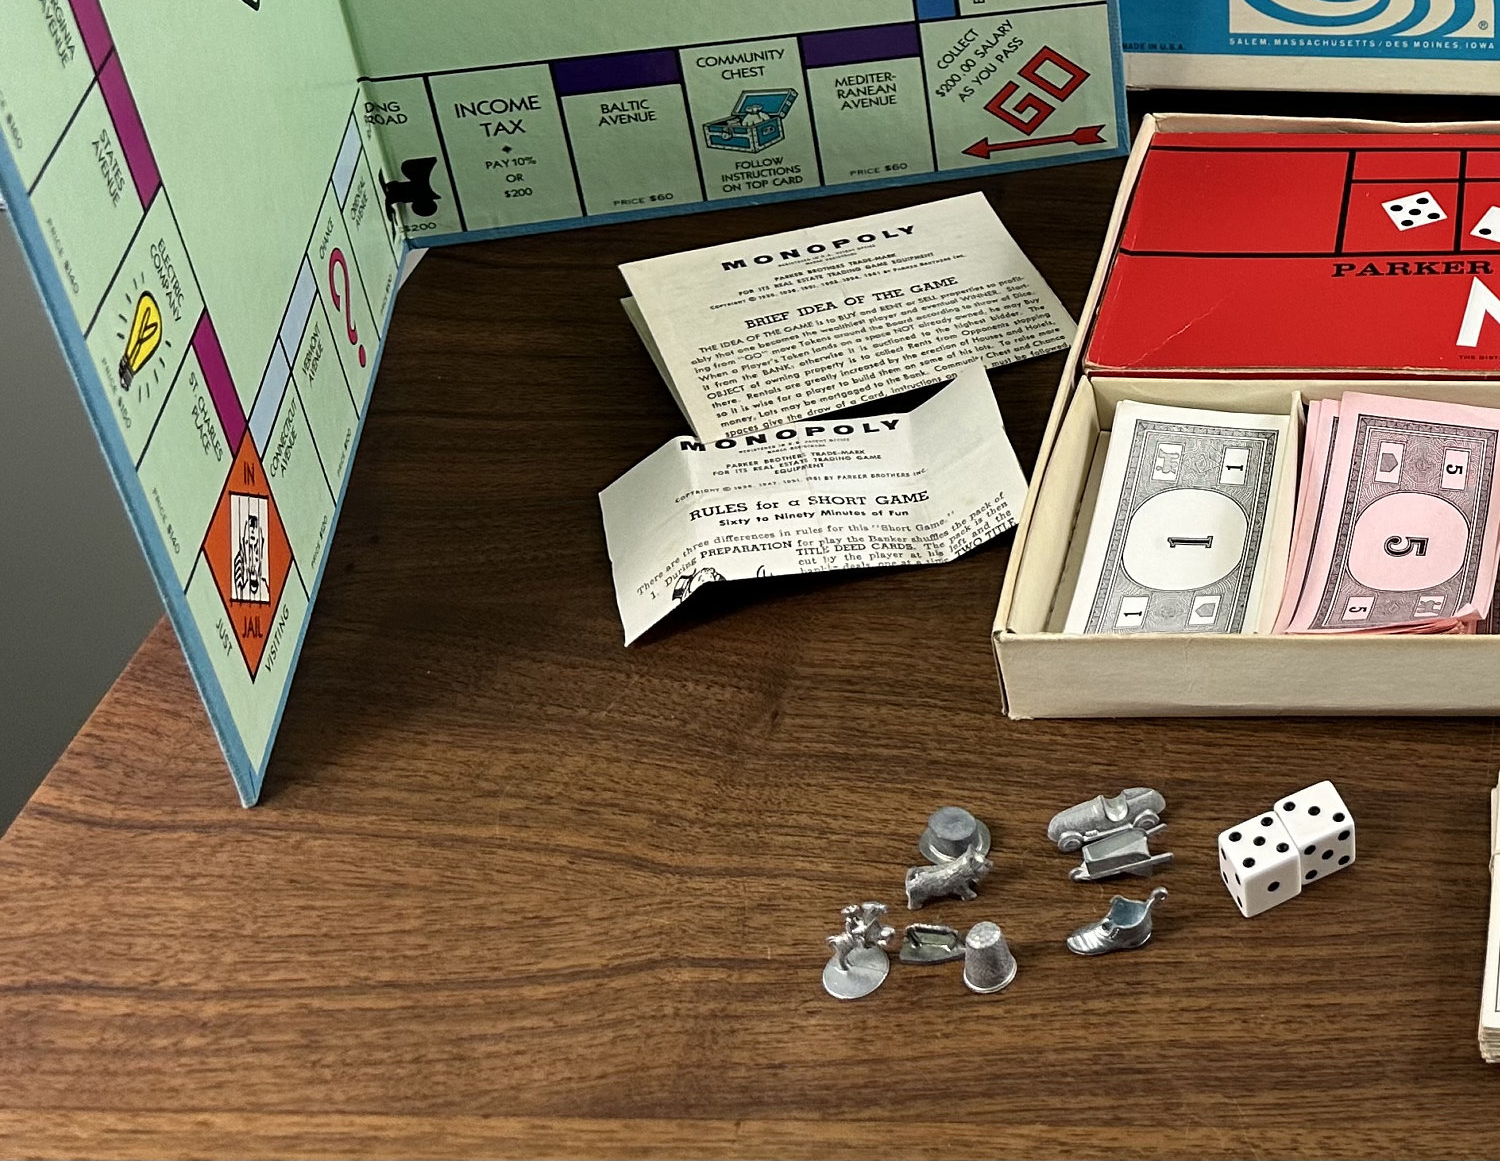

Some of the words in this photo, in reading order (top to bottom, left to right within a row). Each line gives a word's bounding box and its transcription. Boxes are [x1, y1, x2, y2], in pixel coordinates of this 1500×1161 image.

[937, 28, 978, 72] COLLECT
[974, 19, 1014, 58] SALARY
[696, 49, 784, 68] COMMUNITY
[959, 86, 975, 102] AS
[972, 63, 997, 91] YOU
[995, 37, 1023, 63] PASS
[722, 66, 765, 80] CHEST
[835, 72, 896, 87] MEDITER-
[837, 83, 896, 99] RANEAN
[983, 45, 1091, 136] GO
[455, 95, 541, 118] INCOME
[601, 99, 649, 114] BALTIC
[841, 95, 897, 110] AVENUE
[480, 119, 526, 137] TAX
[599, 111, 657, 126] AVENUE
[100, 129, 125, 192] STATES
[485, 159, 509, 169] PAY
[512, 157, 536, 166] 10%
[92, 141, 120, 207] AVENUE
[506, 174, 524, 182] OR
[505, 188, 532, 198] $200
[721, 225, 915, 271] MONOPOLY
[157, 238, 184, 309] ELECTRIC
[1331, 261, 1493, 277] PARKER
[150, 244, 182, 322] COMPANY
[744, 312, 789, 329] BRIEF
[797, 302, 838, 316] IDEA
[844, 296, 864, 305] OF
[872, 289, 904, 301] THE
[910, 277, 958, 293] GAME
[192, 405, 211, 455] PLACE
[198, 396, 223, 462] CHARLES
[680, 419, 899, 454] MONOPOLY
[244, 462, 255, 486] IN
[689, 503, 748, 521] RULES
[756, 501, 779, 510] for
[808, 496, 866, 505] SHORT
[876, 491, 929, 504] GAME
[719, 518, 750, 526] Sixty
[775, 512, 814, 520] Ninety
[1167, 536, 1213, 548] 1
[1384, 536, 1429, 557] 5
[216, 618, 232, 656] JUST
[242, 616, 263, 639] JAIL
[265, 604, 289, 672] VISITING
